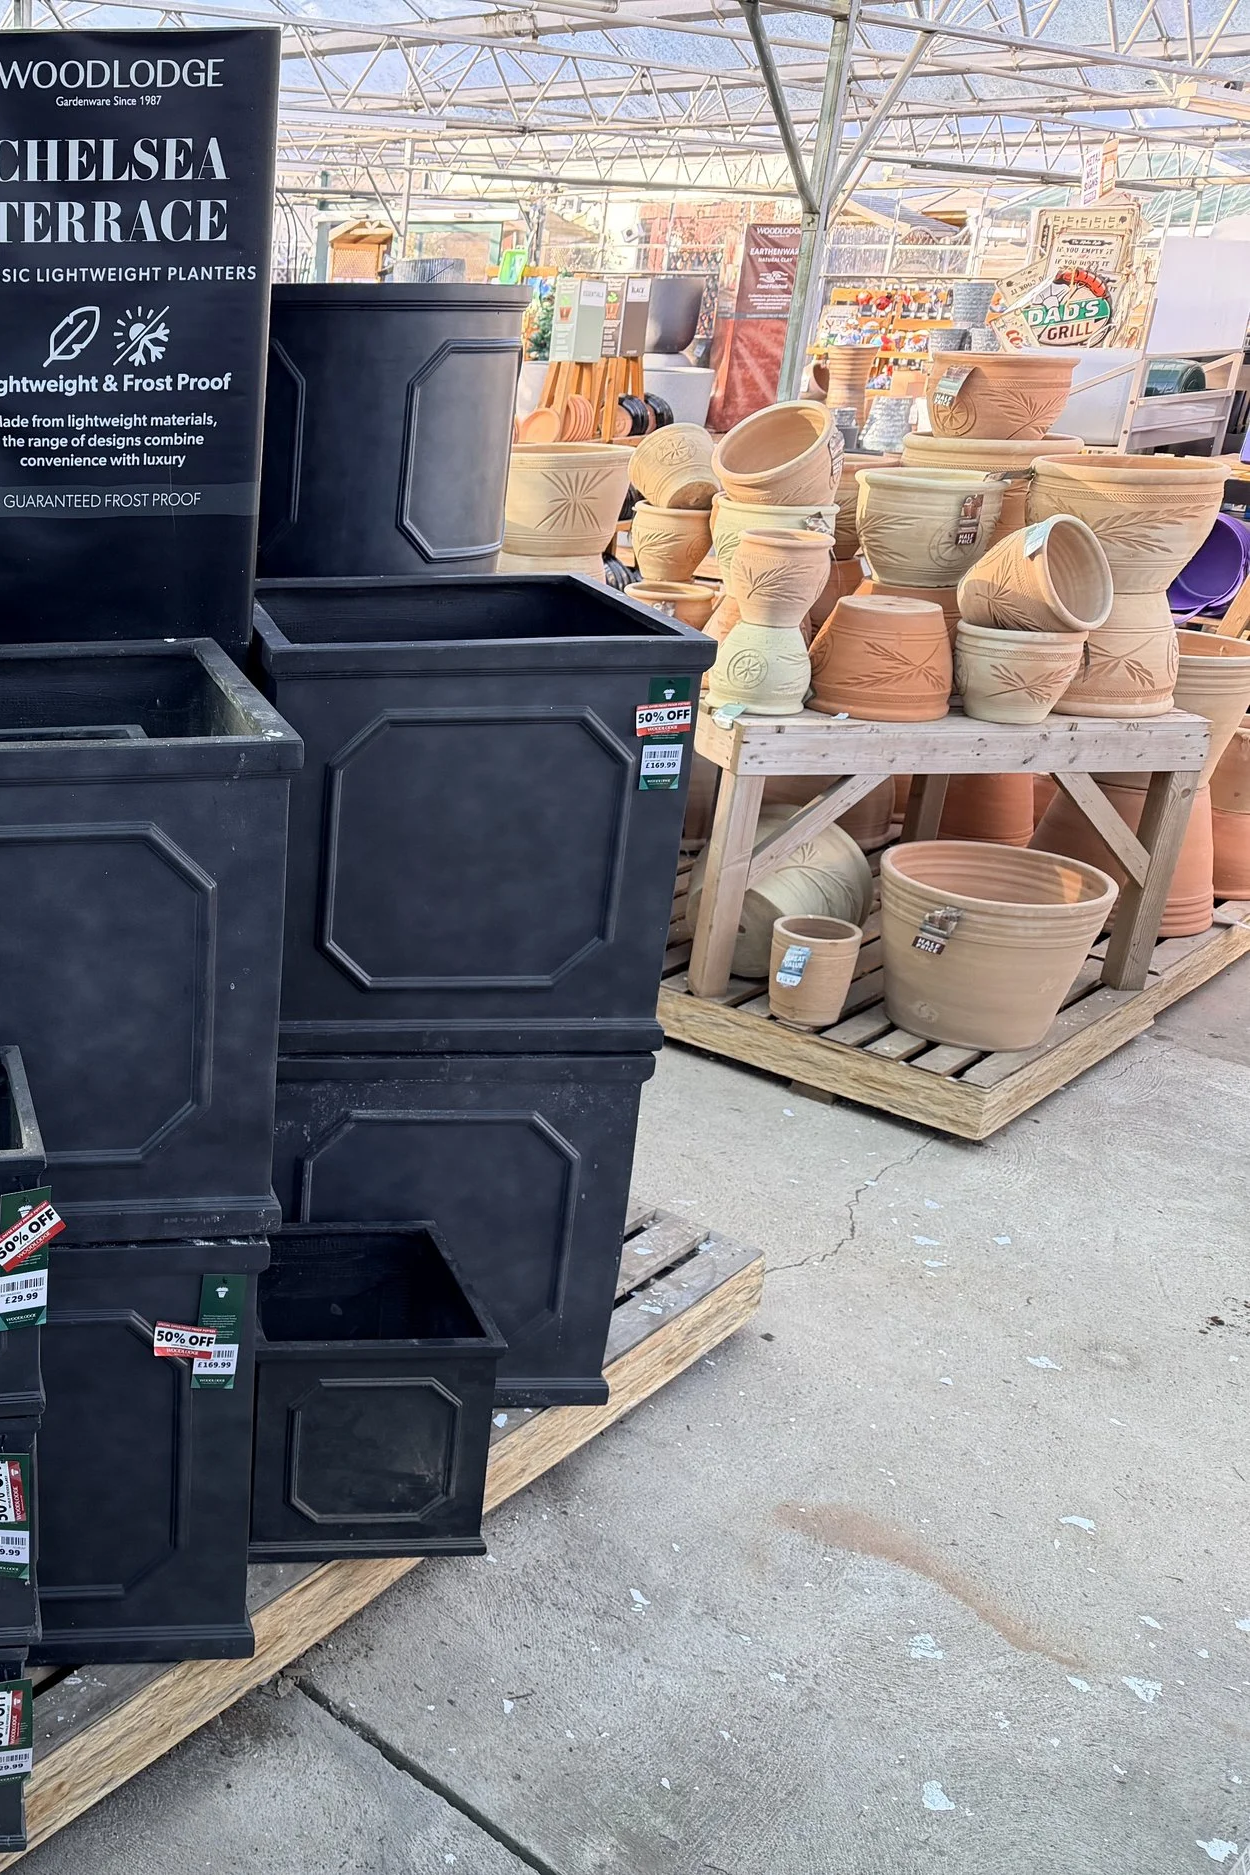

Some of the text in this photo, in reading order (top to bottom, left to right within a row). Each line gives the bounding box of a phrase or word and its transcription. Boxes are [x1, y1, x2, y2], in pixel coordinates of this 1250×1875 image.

[55, 95, 161, 107] Gardenware Since 1987
[37, 266, 162, 283] LIGHTWEIGHT
[167, 265, 257, 281] PLANTERS
[1028, 300, 1100, 326] DAD'S
[1047, 322, 1092, 340] GRILL
[103, 375, 118, 392] &
[123, 374, 173, 391] Frost
[177, 373, 231, 391] Proof
[31, 414, 65, 428] from
[68, 414, 147, 431] lightweight
[151, 413, 217, 427] materials,
[2, 433, 204, 451] the range of designs combine
[20, 453, 186, 469] convenience with luxury
[3, 492, 201, 508] GUARANTEED FROST PROOF
[638, 709, 690, 724] 50% OFF
[29, 1208, 55, 1233] OFF
[5, 1292, 38, 1304] £29.99
[157, 1331, 214, 1347] 50% OFF
